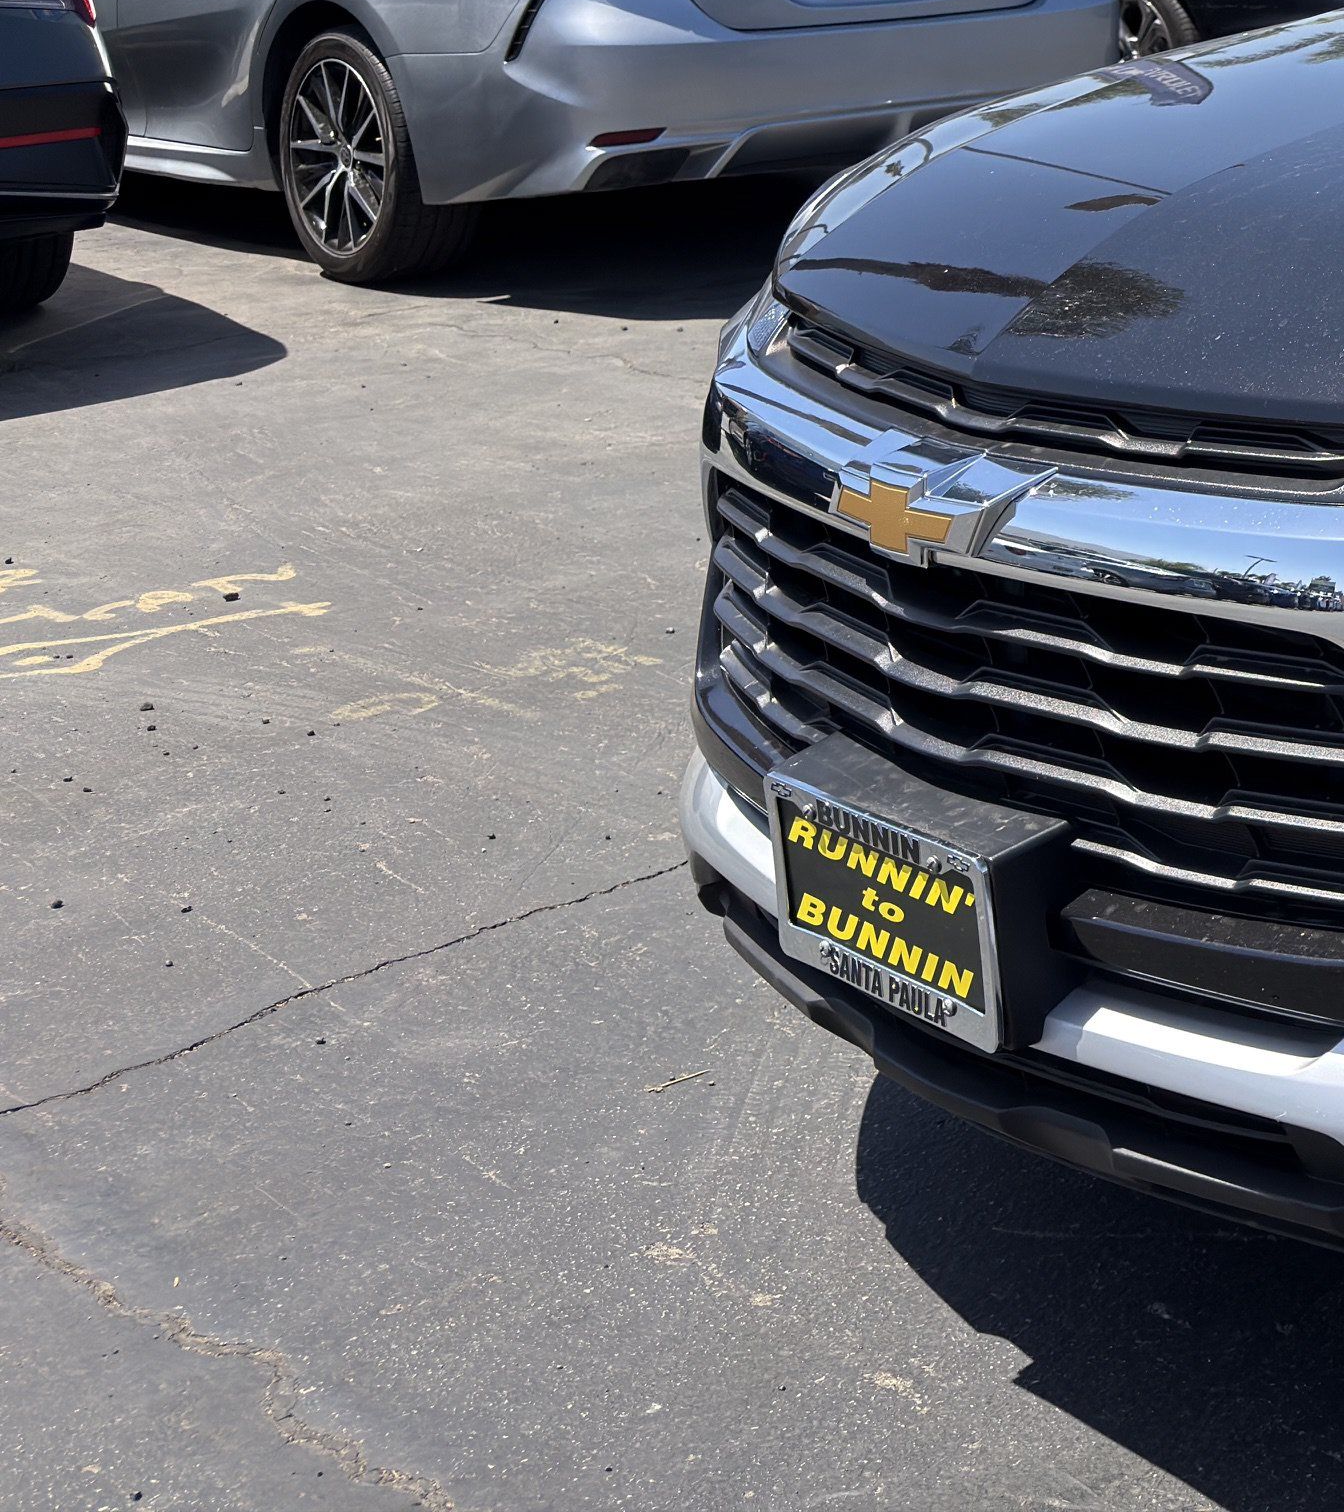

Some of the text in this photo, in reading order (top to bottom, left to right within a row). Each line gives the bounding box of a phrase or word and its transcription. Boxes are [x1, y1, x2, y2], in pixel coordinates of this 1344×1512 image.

[787, 816, 976, 915] RUNNIN'
[815, 799, 920, 864] BUNNIN
[861, 886, 905, 923] to
[796, 892, 975, 999] BUNNIN
[830, 947, 949, 1028] SANTA PAULA
